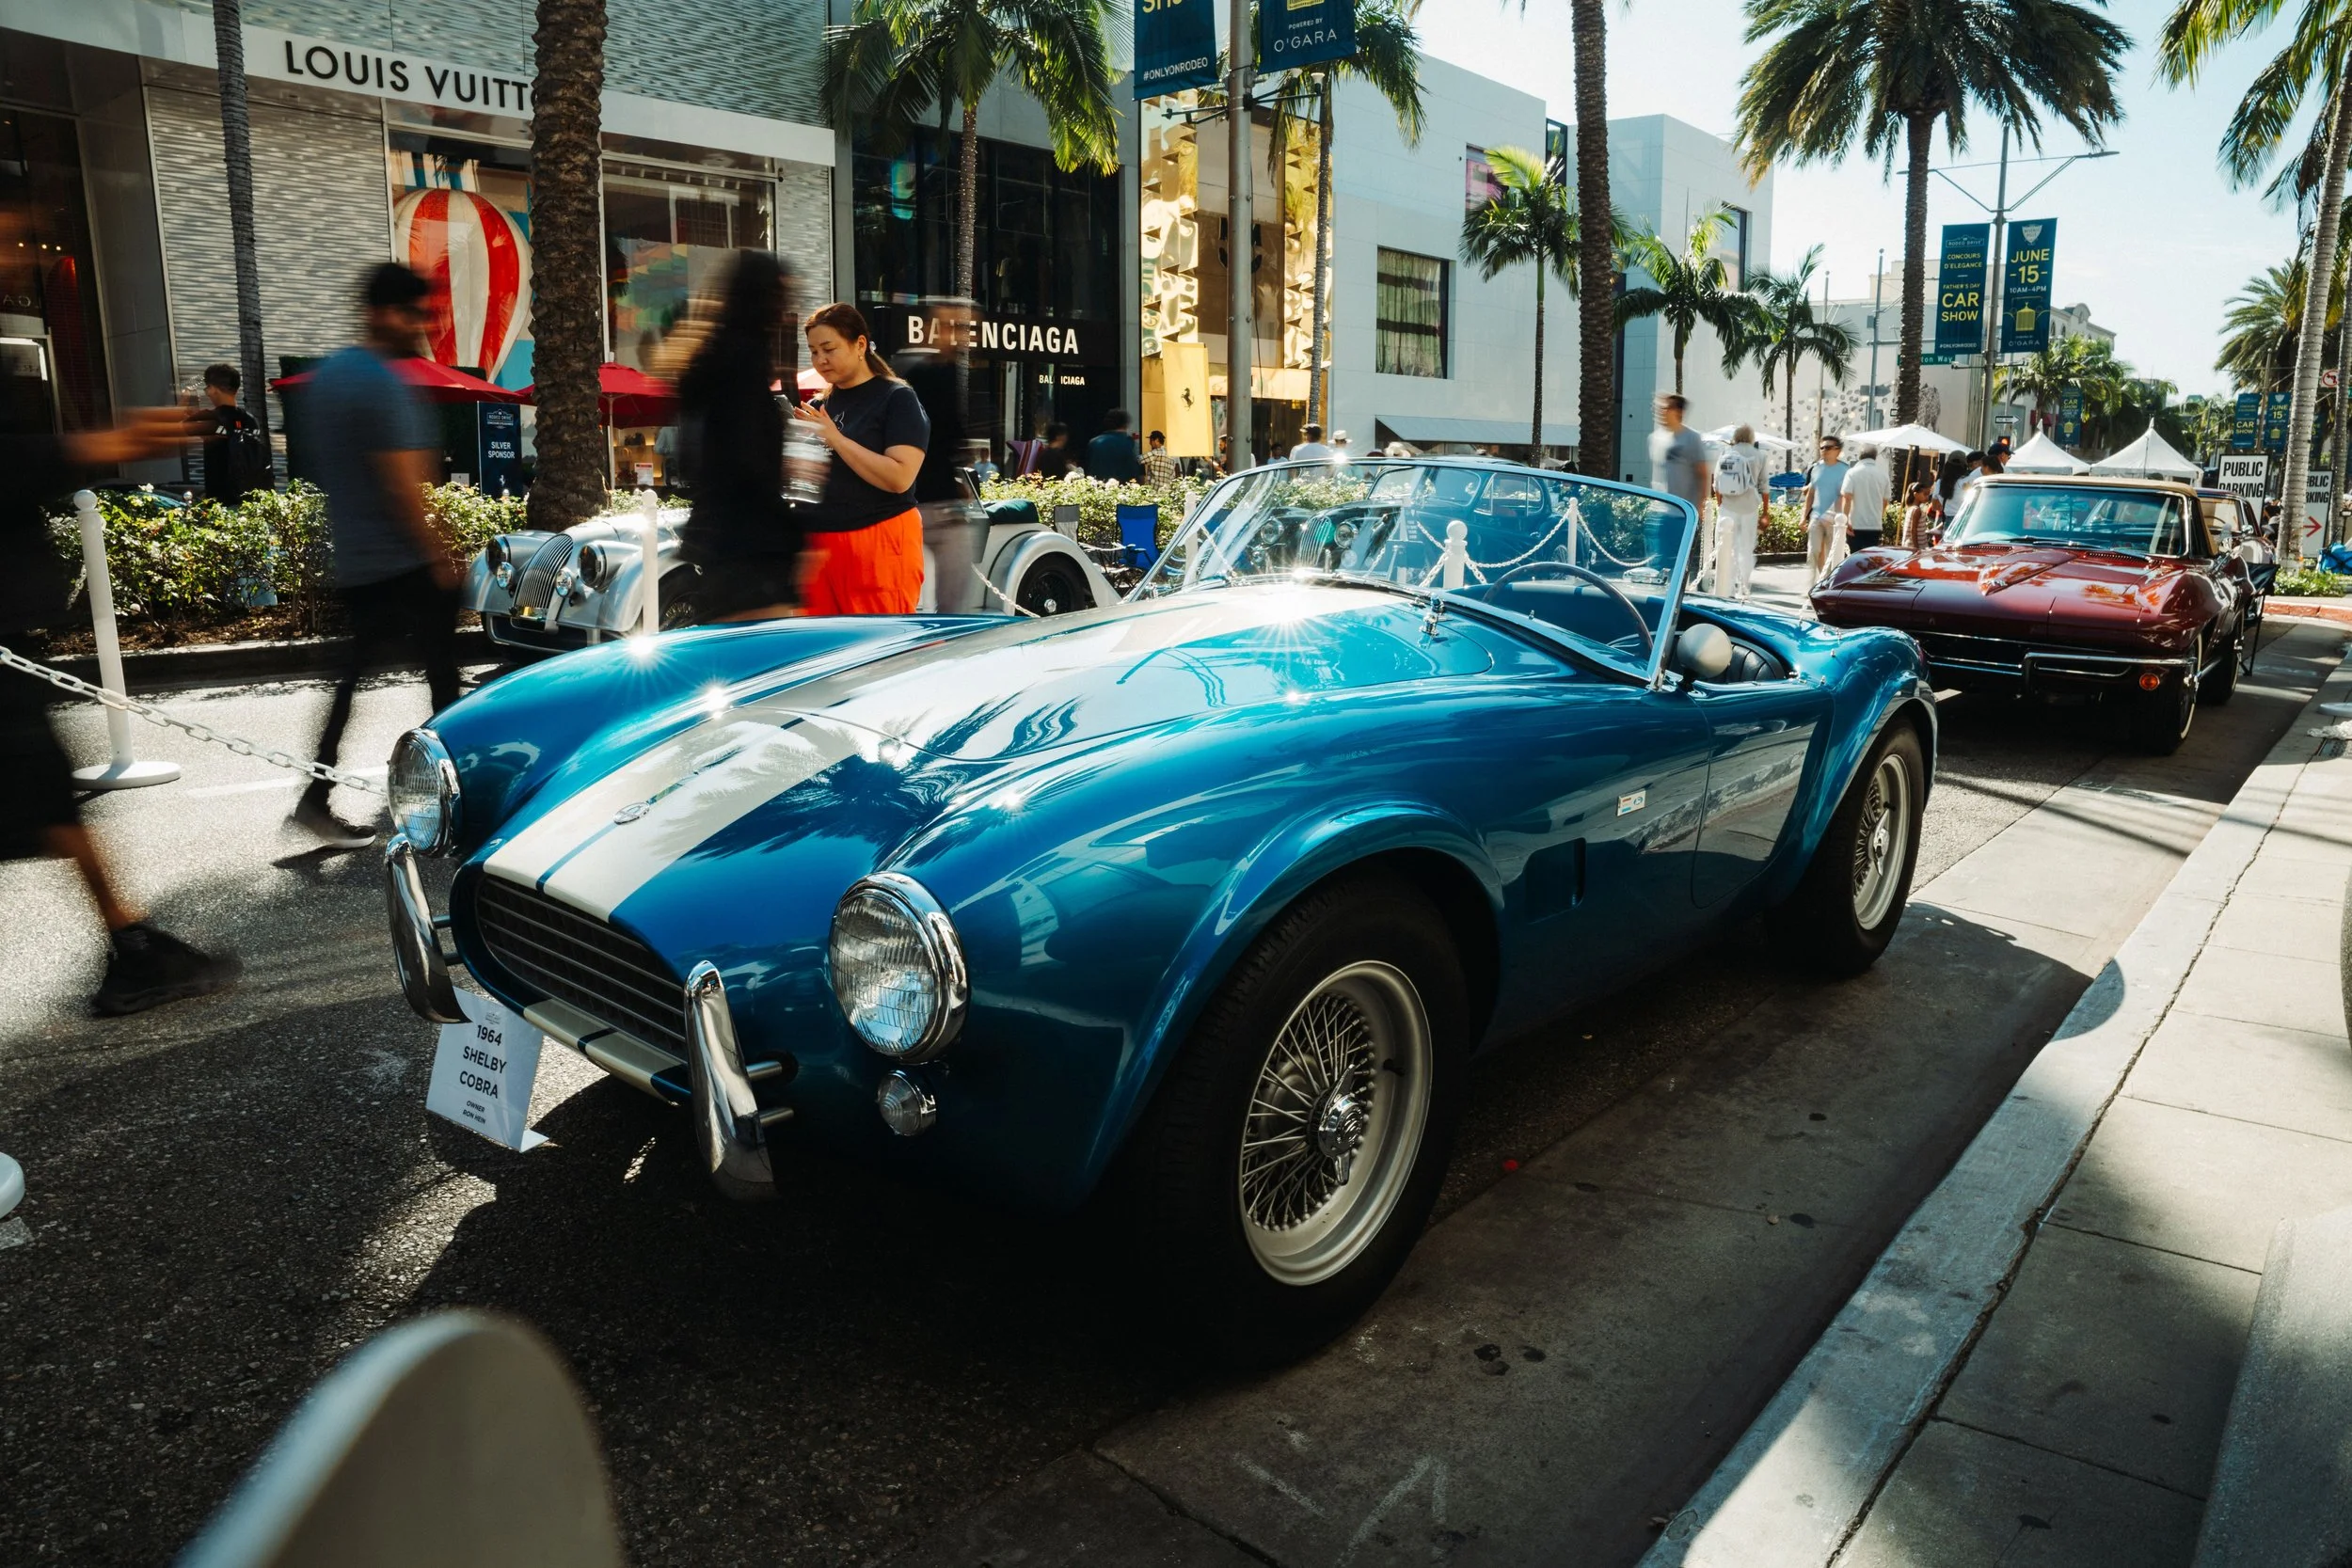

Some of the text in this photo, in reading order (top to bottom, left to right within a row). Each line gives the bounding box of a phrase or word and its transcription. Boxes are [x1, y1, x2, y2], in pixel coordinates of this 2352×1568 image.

[1288, 20, 1314, 29] POWERED
[1274, 28, 1338, 53] O'GARA
[285, 40, 409, 92] LOUIS
[1143, 56, 1208, 81] #ONLYONRODEO
[2010, 248, 2050, 263] JUNE
[1944, 261, 1982, 270] D'ELEGANCE
[1942, 292, 1979, 308] CAR
[1941, 310, 1979, 322] SHOW
[1938, 356, 1953, 364] Way
[2223, 461, 2264, 477] PUBLIC
[2307, 475, 2328, 487] BLIC
[2306, 491, 2328, 503] RKING
[477, 1024, 502, 1046] 1964
[463, 1046, 507, 1074] SHELBY
[459, 1070, 498, 1099] COBRA
[463, 1109, 474, 1118] RON
[467, 1100, 485, 1113] OWNER
